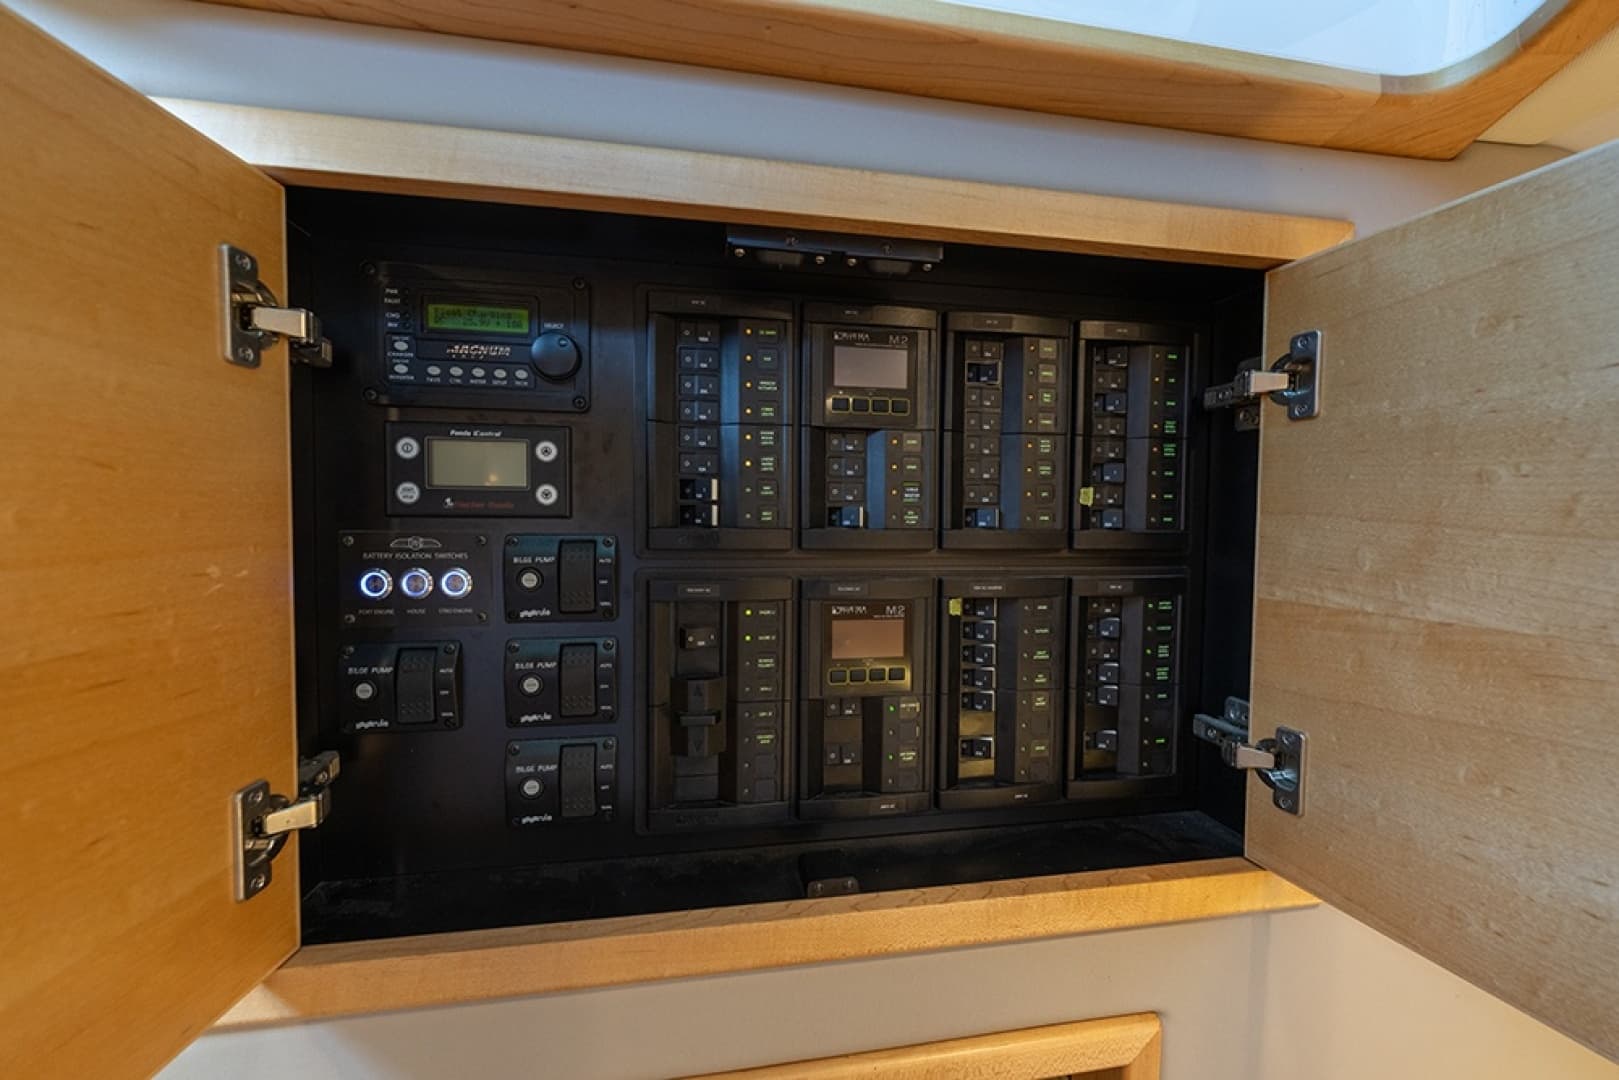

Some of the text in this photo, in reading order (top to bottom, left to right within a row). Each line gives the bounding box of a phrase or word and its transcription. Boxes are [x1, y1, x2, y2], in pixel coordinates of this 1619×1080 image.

[889, 334, 909, 345] M2
[446, 344, 511, 356] MAGNUM
[362, 552, 469, 560] BATTERY ISOLATION SWITCHES
[513, 556, 532, 564] BILGE
[885, 605, 906, 615] M2
[514, 661, 557, 670] BILGE PUMP
[347, 666, 394, 675] BILGE PUMP
[515, 764, 558, 774] BILGE PUMP
